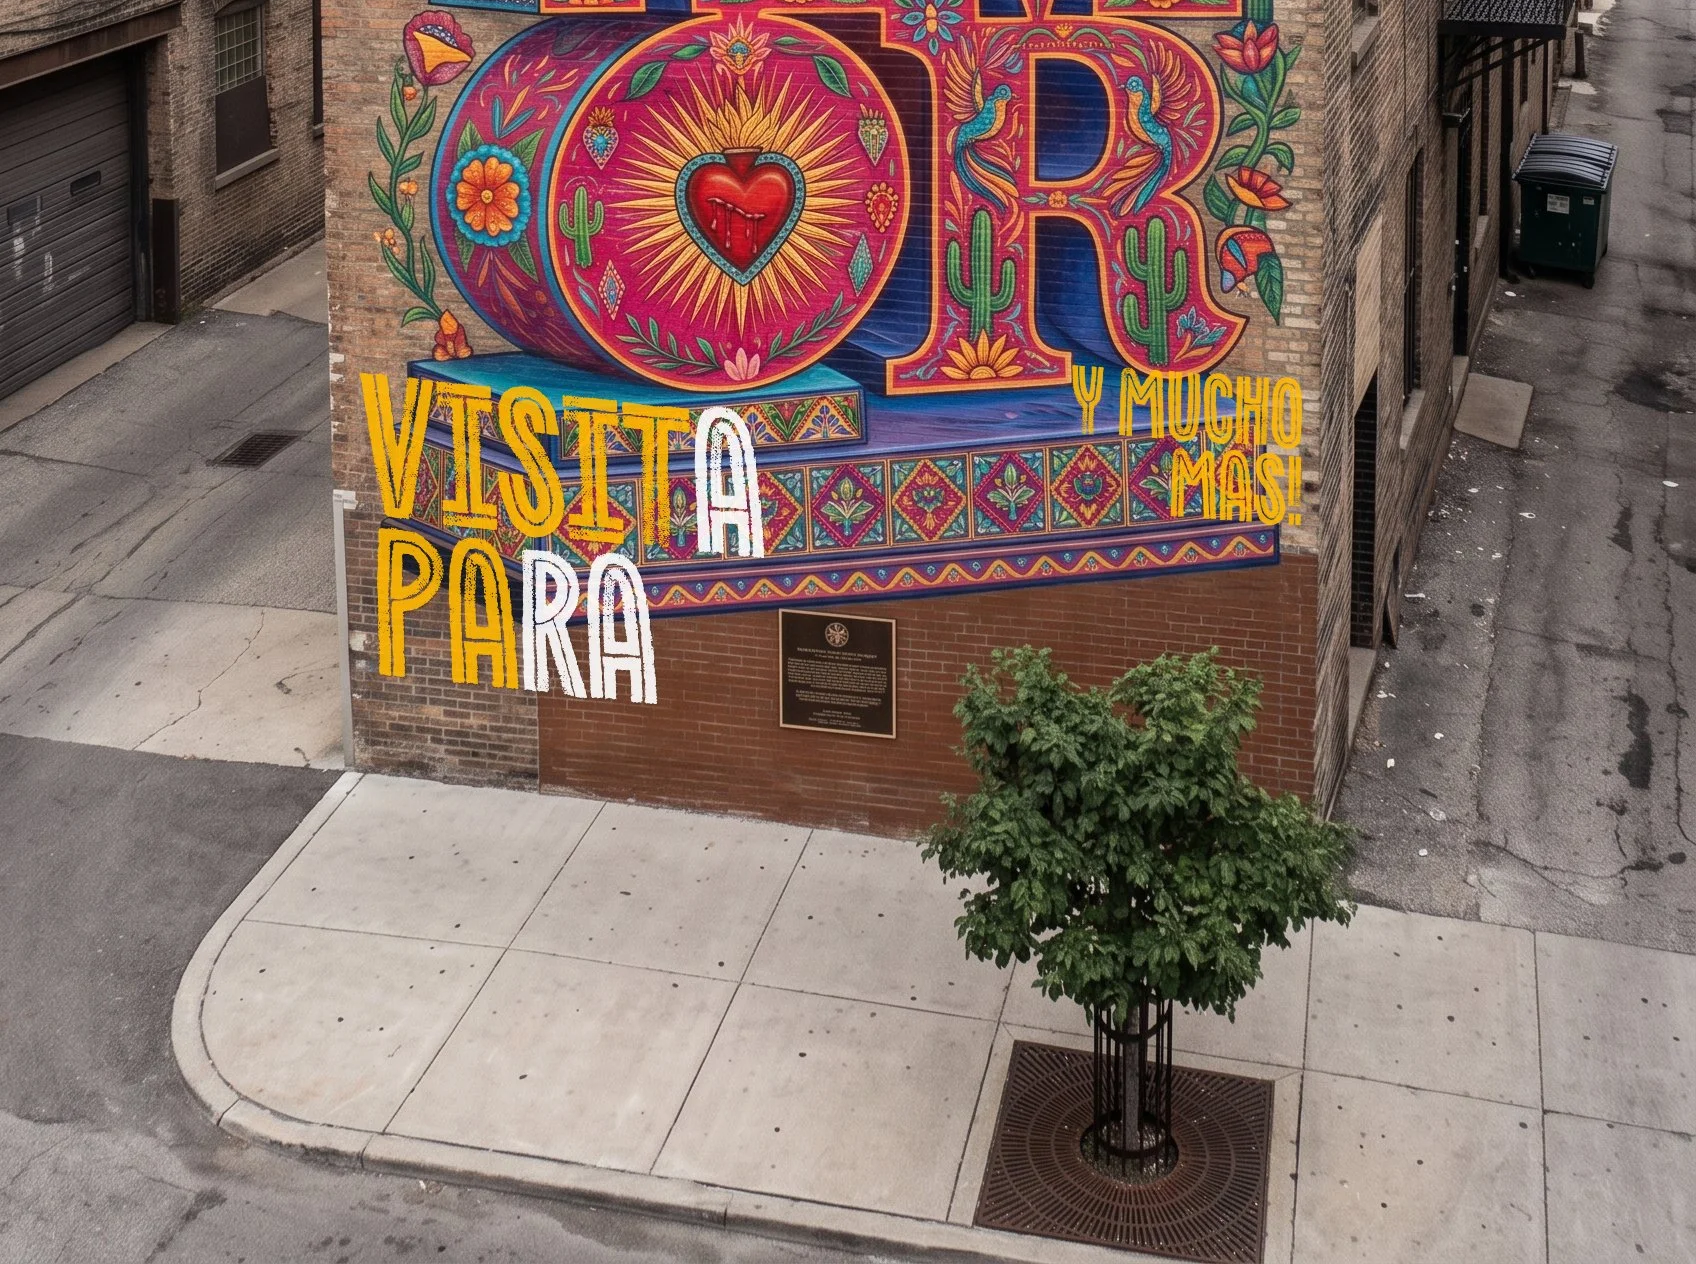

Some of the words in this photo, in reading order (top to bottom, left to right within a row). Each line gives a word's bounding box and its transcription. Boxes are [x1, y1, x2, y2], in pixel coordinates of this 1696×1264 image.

[359, 373, 764, 558] VISITA
[1072, 365, 1104, 434] Y
[1119, 368, 1302, 449] MUCHO
[1170, 449, 1302, 525] MAS!
[378, 527, 657, 704] PARA
